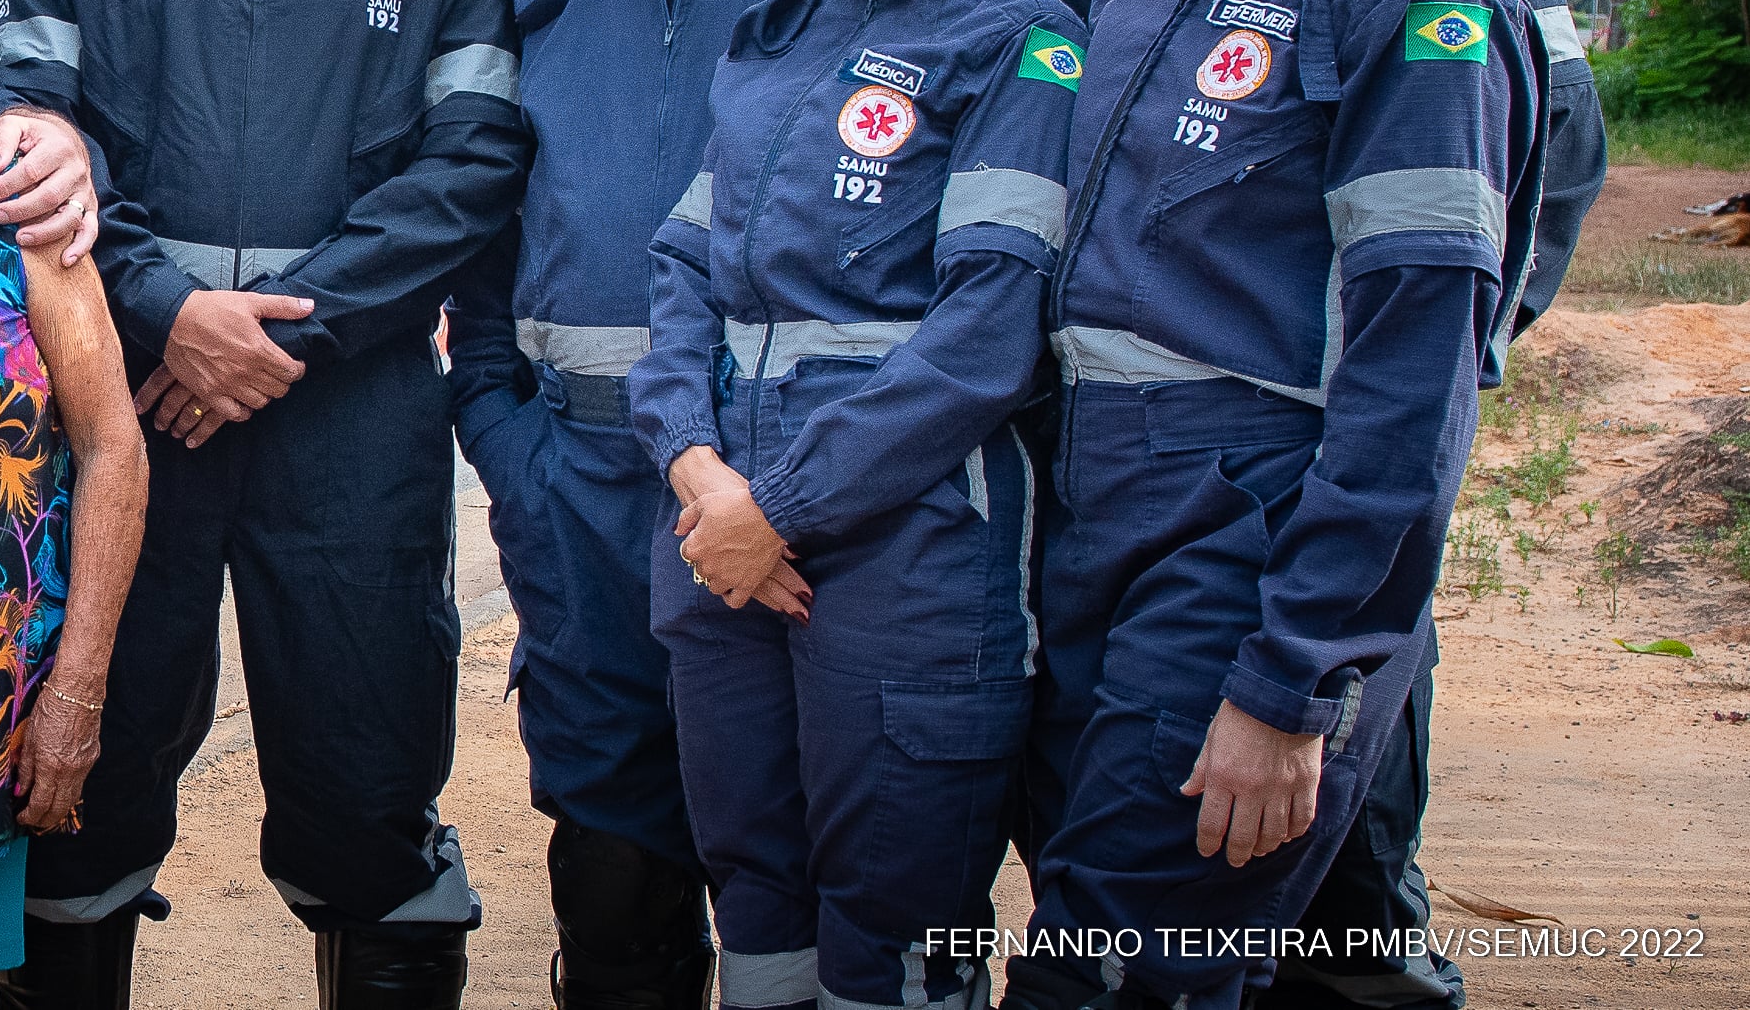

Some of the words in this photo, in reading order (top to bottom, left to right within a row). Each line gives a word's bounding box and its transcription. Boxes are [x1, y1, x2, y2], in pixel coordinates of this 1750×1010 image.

[366, 7, 400, 33] 192
[860, 60, 915, 89] MÉDICA
[1183, 97, 1229, 122] SAMU
[1172, 115, 1220, 152] 192
[837, 155, 889, 177] SAMU
[833, 172, 883, 204] 192
